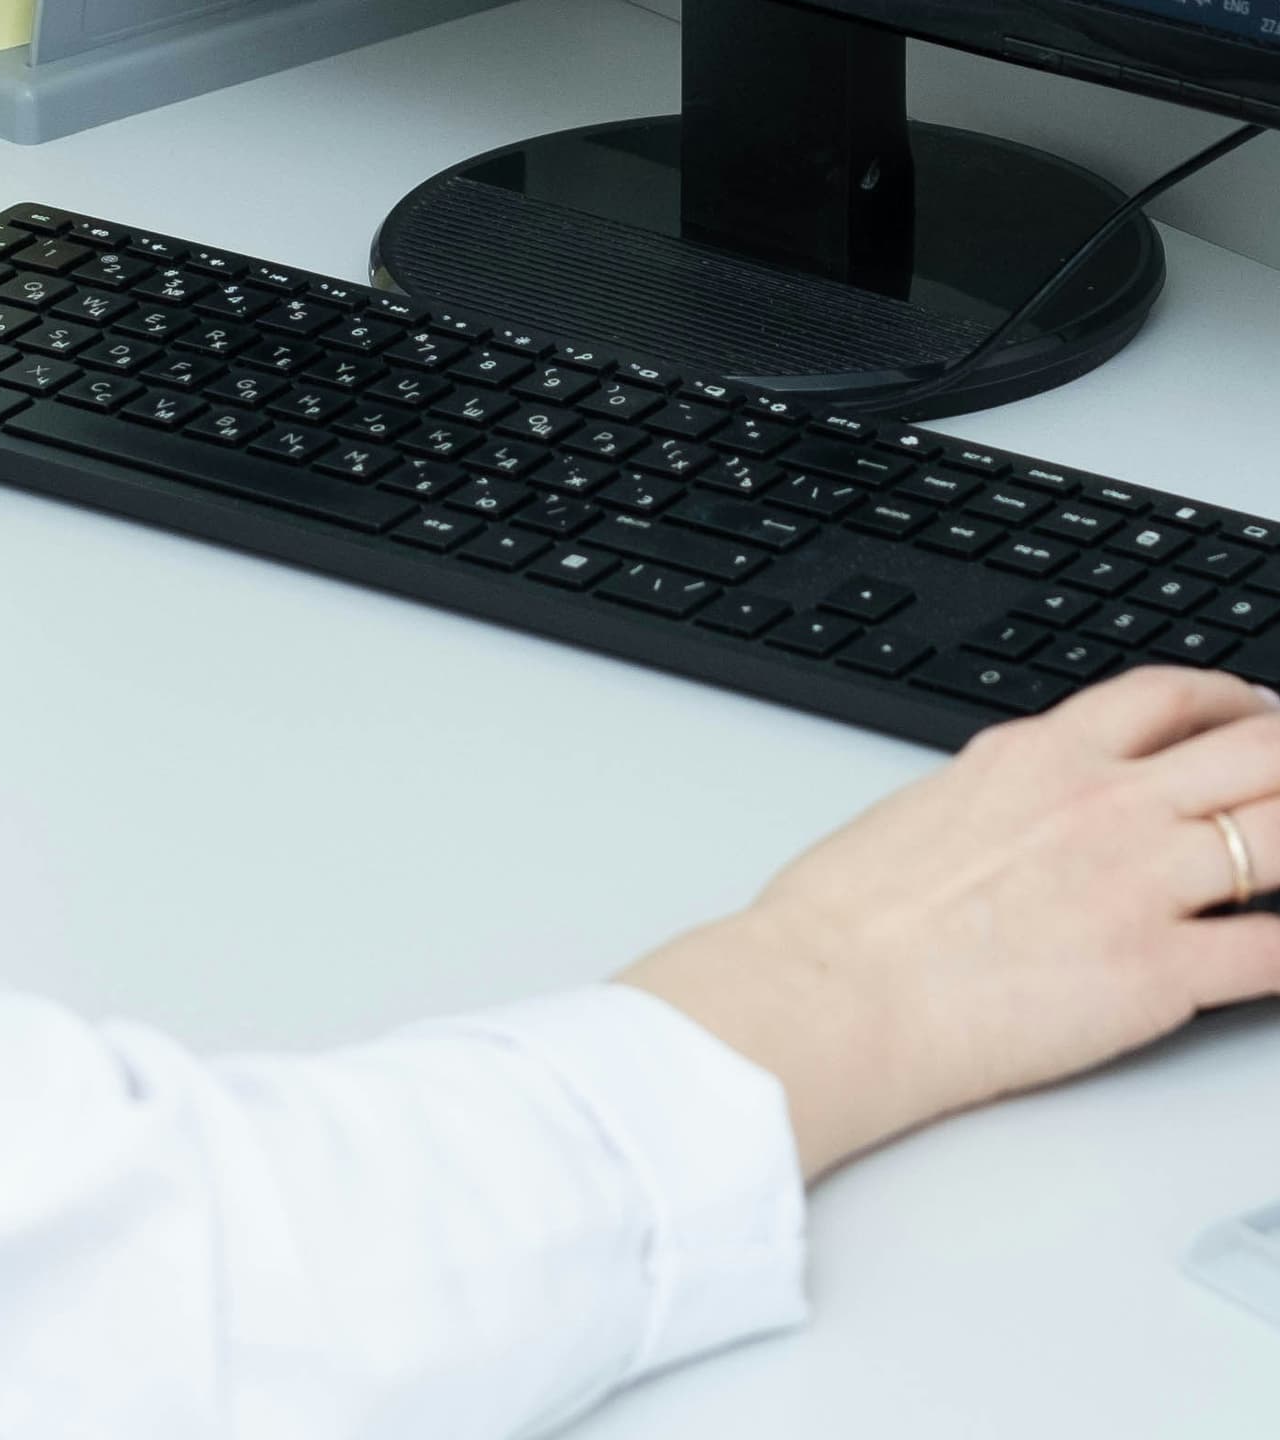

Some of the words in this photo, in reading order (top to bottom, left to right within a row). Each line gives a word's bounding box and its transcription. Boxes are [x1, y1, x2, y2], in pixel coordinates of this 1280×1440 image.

[103, 264, 121, 273] 2
[24, 281, 43, 292] Q
[165, 279, 184, 288] 3
[82, 296, 109, 307] W
[227, 295, 244, 304] 4
[145, 313, 166, 324] E
[289, 311, 308, 320] 5
[49, 329, 68, 340] S
[205, 330, 227, 341] R
[351, 327, 368, 336] 6
[109, 345, 130, 356] D
[273, 346, 291, 356] T
[417, 343, 436, 352] 7
[170, 362, 192, 371] F
[336, 363, 356, 373] Y
[480, 360, 497, 370] 8
[236, 379, 257, 389] G
[398, 380, 419, 390] U
[544, 378, 561, 387] 9
[156, 398, 176, 409] V
[280, 433, 304, 444] N
[495, 448, 508, 459] L
[1093, 562, 1113, 574] 7
[1161, 582, 1181, 595] 8
[1046, 594, 1065, 609] 4
[1232, 601, 1252, 614] 9
